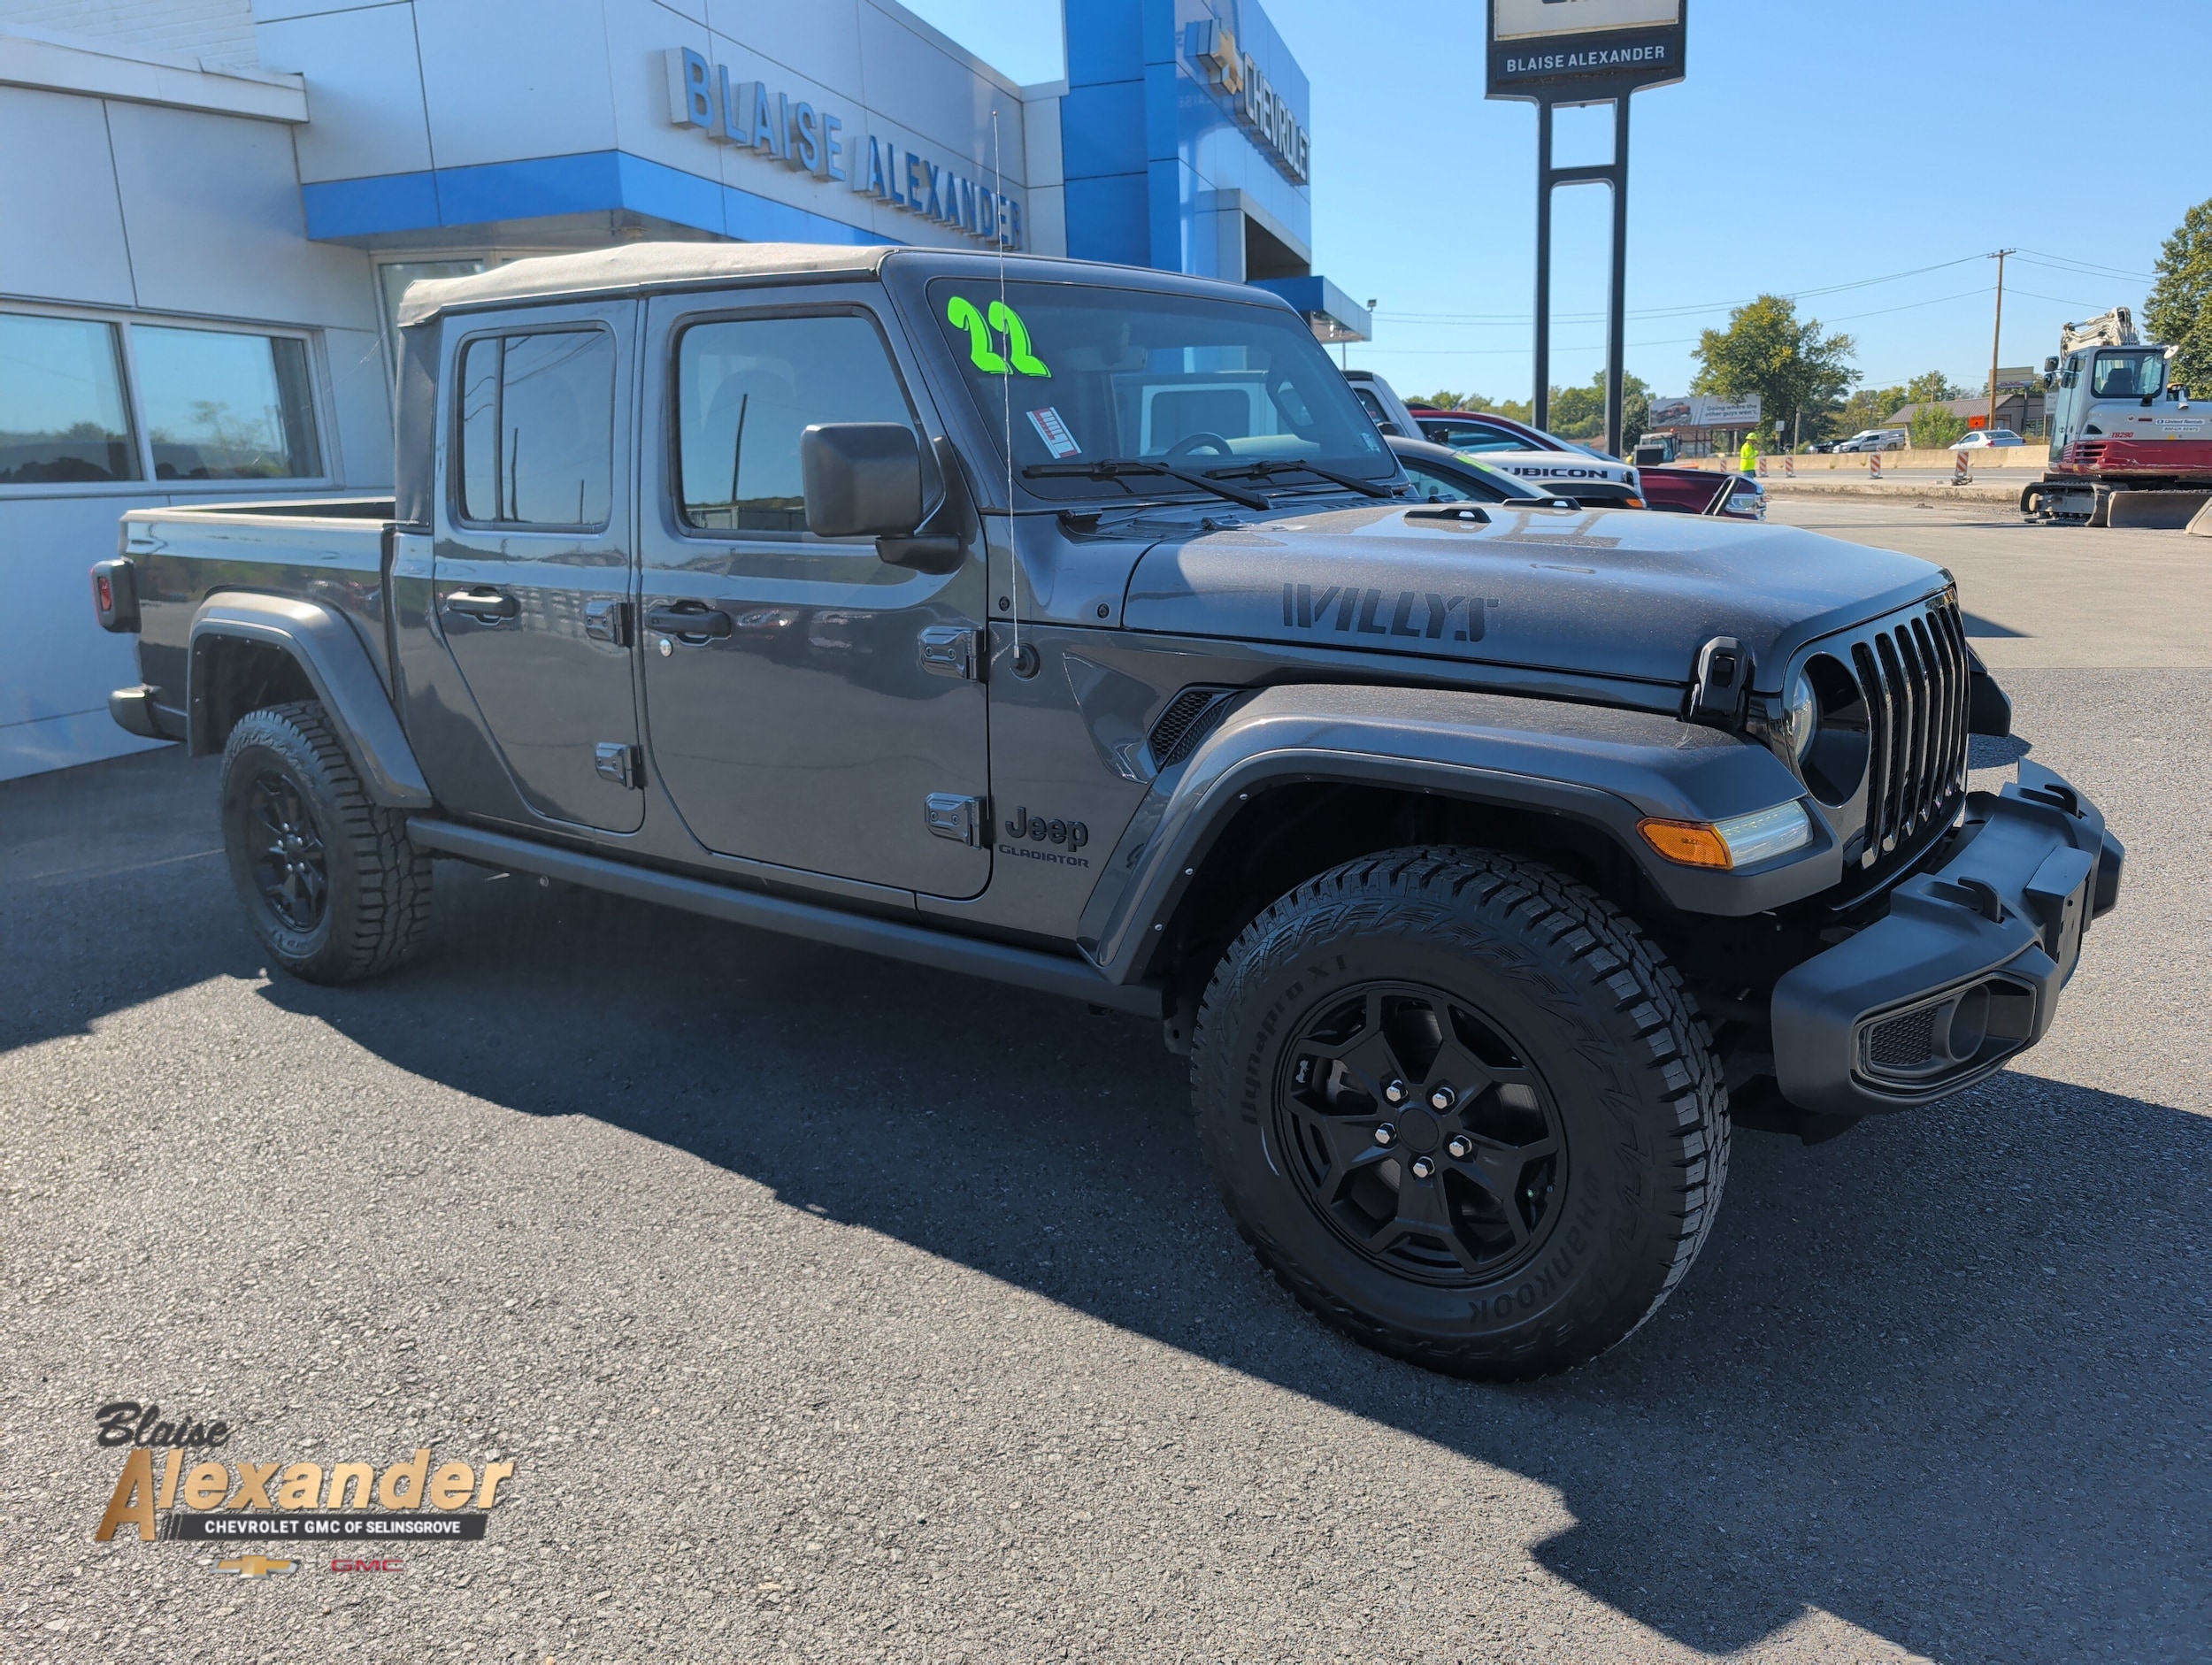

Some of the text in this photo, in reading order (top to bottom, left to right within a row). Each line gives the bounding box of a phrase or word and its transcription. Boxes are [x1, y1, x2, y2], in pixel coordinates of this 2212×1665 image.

[1506, 45, 1665, 73] BLAISE ALEXANDER
[1242, 52, 1310, 185] CHEVROLET
[678, 47, 1024, 250] BLAISE ALEXANDER
[947, 296, 1052, 378] 22
[1502, 467, 1608, 479] UBICON
[1283, 582, 1500, 642] WILLYS
[1005, 806, 1088, 852] Jeep
[998, 844, 1089, 868] GLADIATOR
